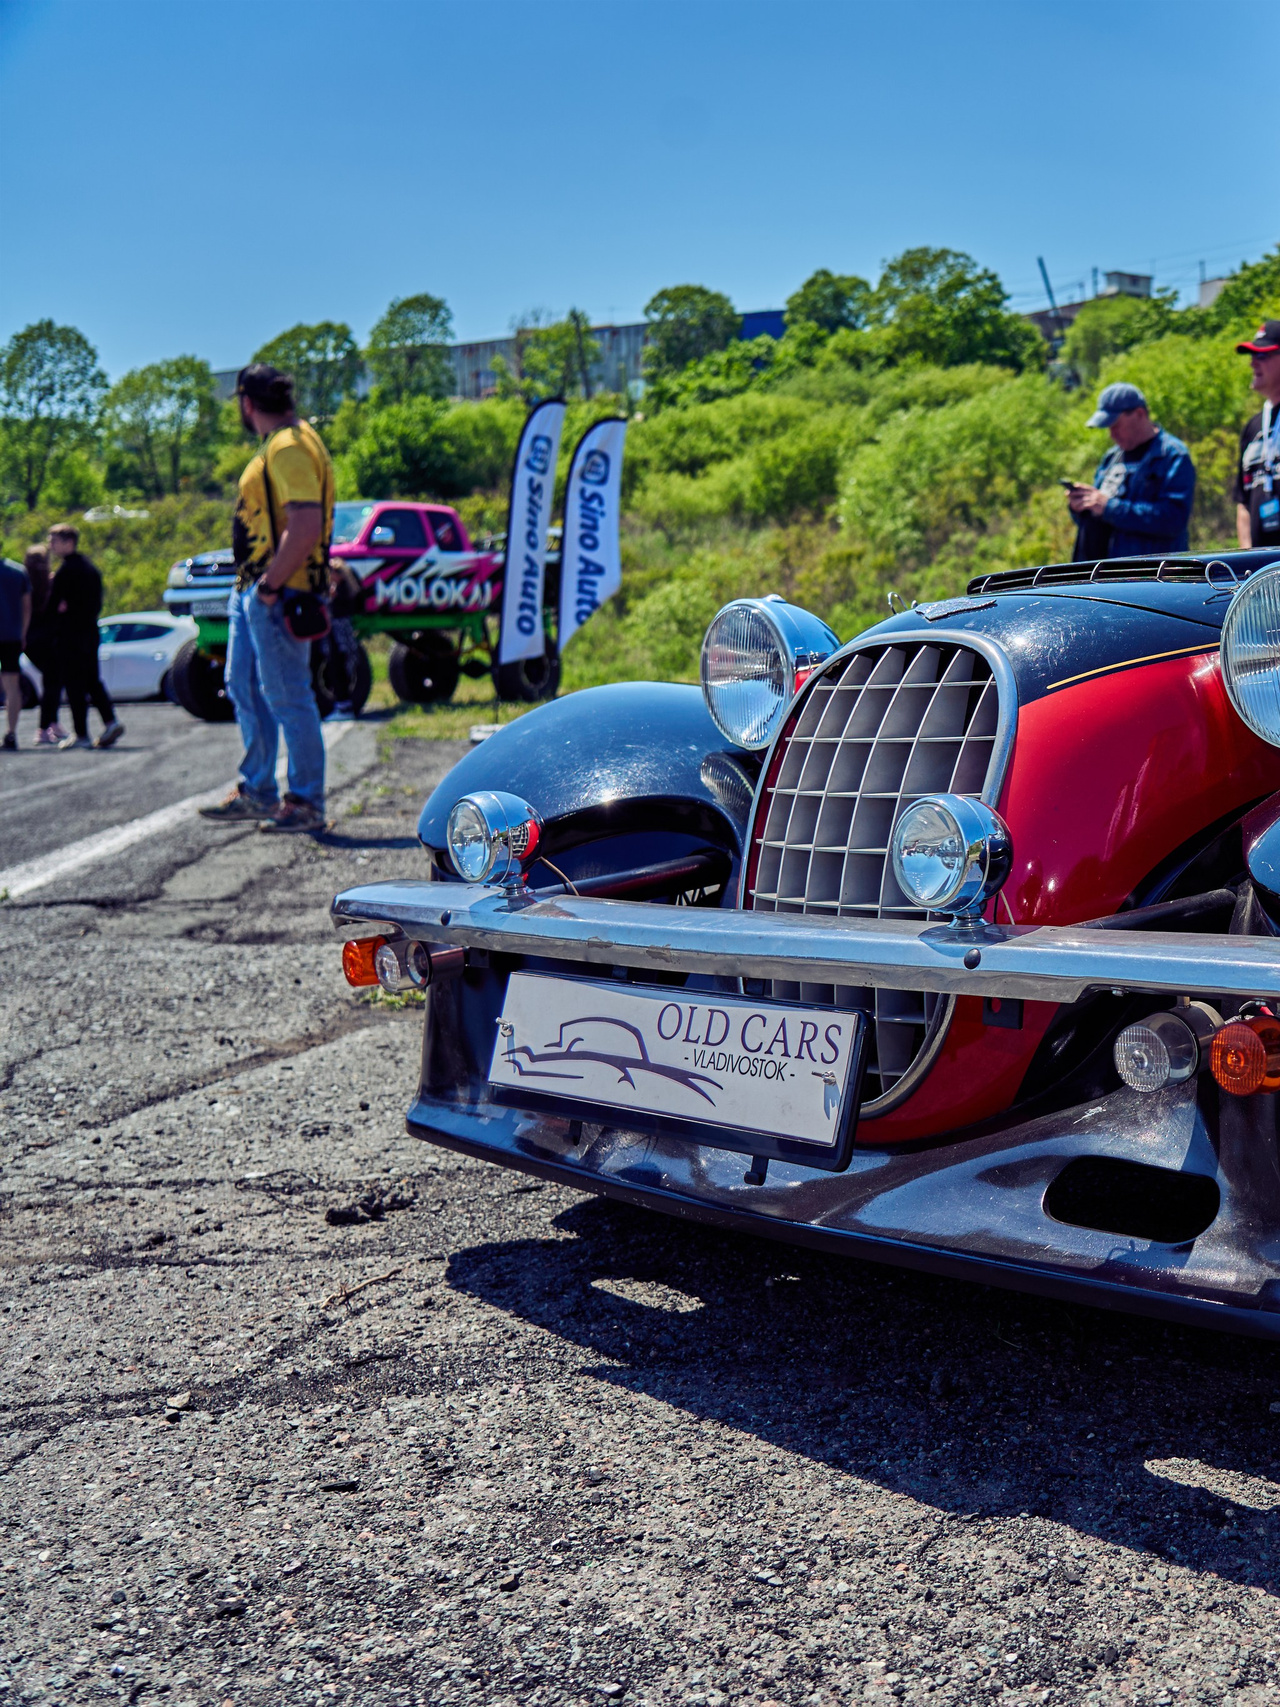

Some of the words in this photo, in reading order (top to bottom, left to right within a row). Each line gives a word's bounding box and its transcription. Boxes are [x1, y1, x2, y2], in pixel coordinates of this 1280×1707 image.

[526, 476, 544, 551] Sino
[578, 486, 606, 552] Sino
[375, 575, 492, 609] MOLOKAI
[515, 553, 539, 637] Auto
[657, 1003, 730, 1047] OLD
[741, 1013, 842, 1065] CARS
[693, 1048, 788, 1082] VLADIVOSTOK
